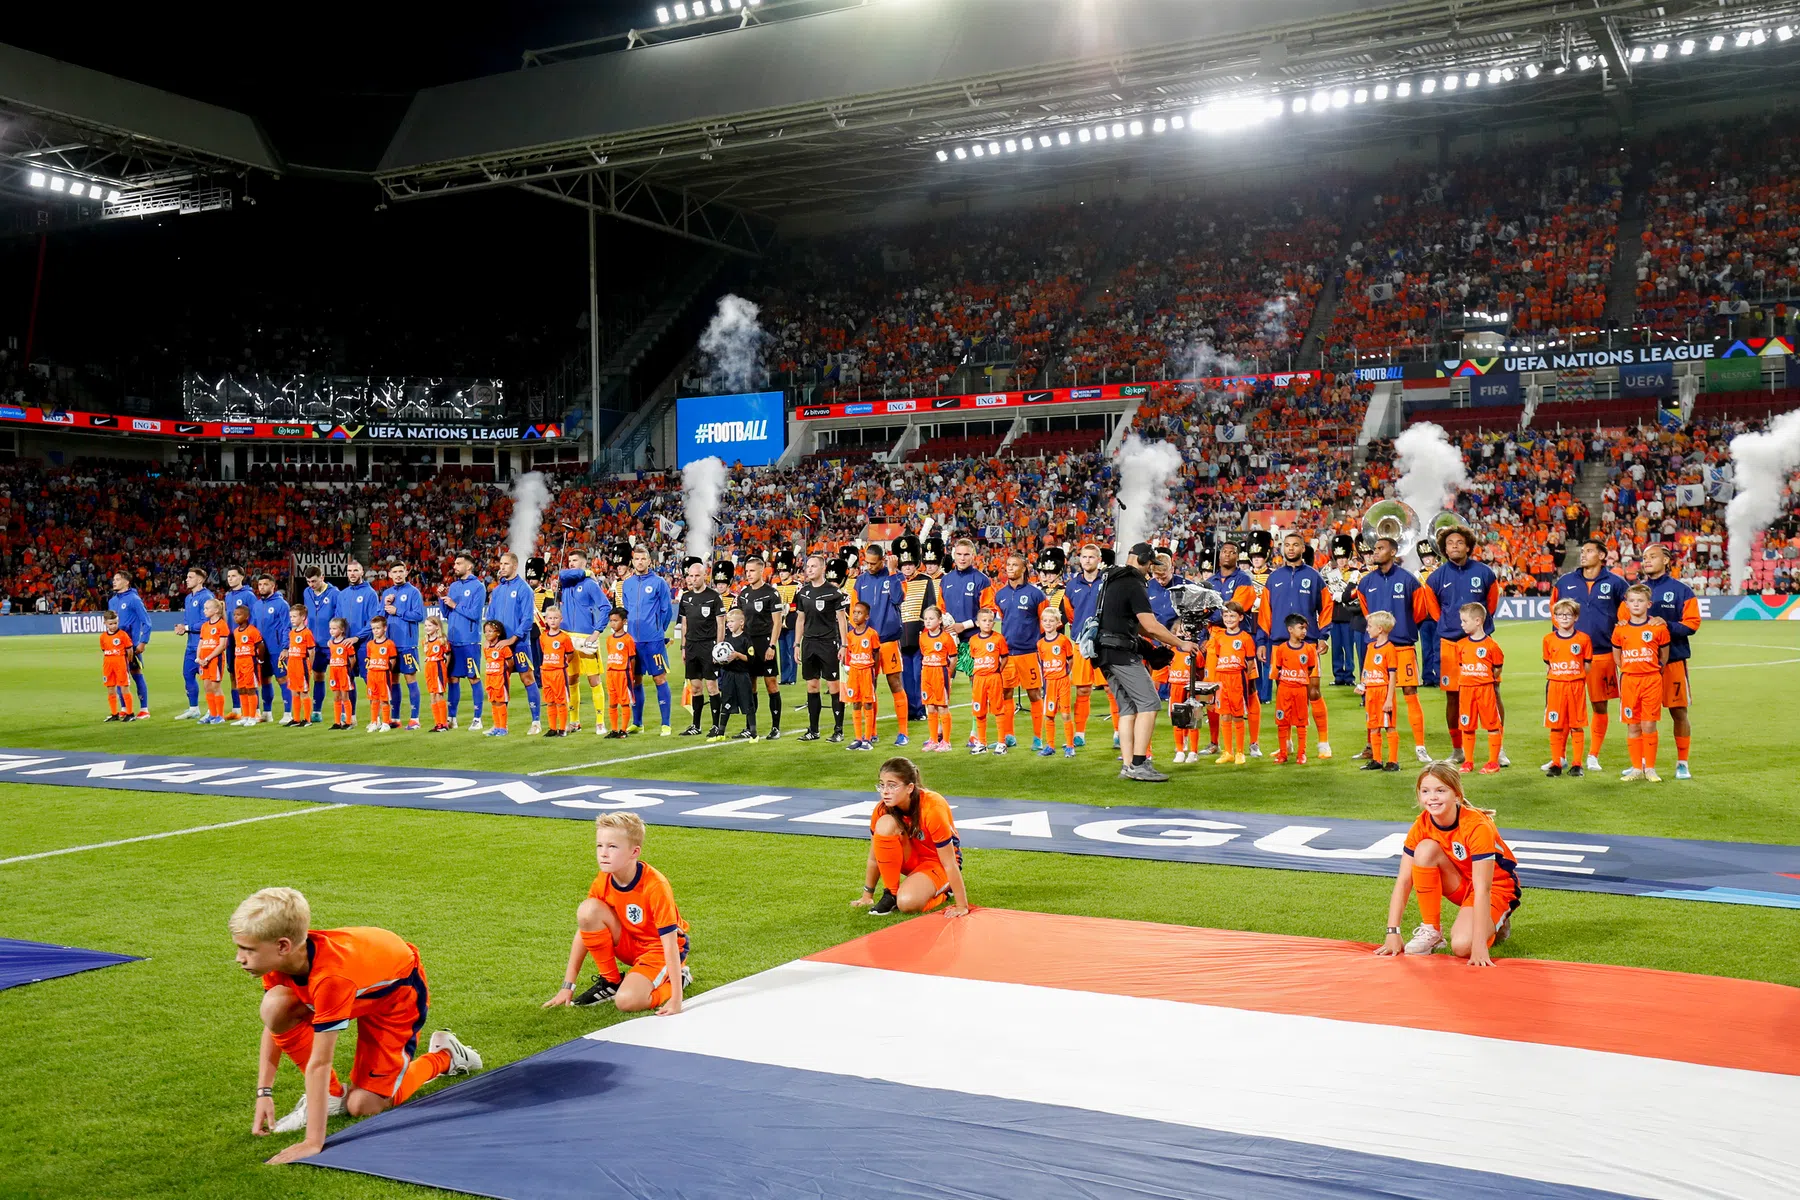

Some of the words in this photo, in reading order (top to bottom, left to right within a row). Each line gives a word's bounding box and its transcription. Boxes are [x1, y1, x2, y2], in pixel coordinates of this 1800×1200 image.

[1504, 355, 1548, 371] UEFA
[1553, 348, 1634, 368] NATIONS
[1640, 343, 1715, 362] LEAGUE
[1277, 376, 1288, 386] IN
[1625, 375, 1665, 388] UEFA
[1480, 385, 1507, 396] FIFA
[888, 403, 904, 411] ING
[977, 396, 993, 405] ING
[134, 421, 150, 430] ING
[286, 427, 300, 435] kpn
[695, 419, 768, 444] #FOOTBALL
[369, 427, 403, 439] UEFA
[407, 427, 468, 440] NATIONS
[472, 428, 519, 440] LEAGUE
[295, 552, 349, 565] VORTUM
[297, 564, 348, 577] MLEM
[1493, 599, 1552, 618] ATIO
[403, 653, 413, 665] 15
[515, 652, 525, 663] 18
[653, 653, 662, 666] 11
[891, 652, 898, 665] 4
[1622, 649, 1639, 658] ING
[467, 657, 473, 669] 5
[1030, 667, 1037, 680] 5
[1405, 663, 1414, 677] 6
[1603, 676, 1616, 690] 14
[1673, 682, 1681, 696] 7
[15, 759, 698, 810] NATIONS
[680, 794, 1609, 874] LEAGUE
